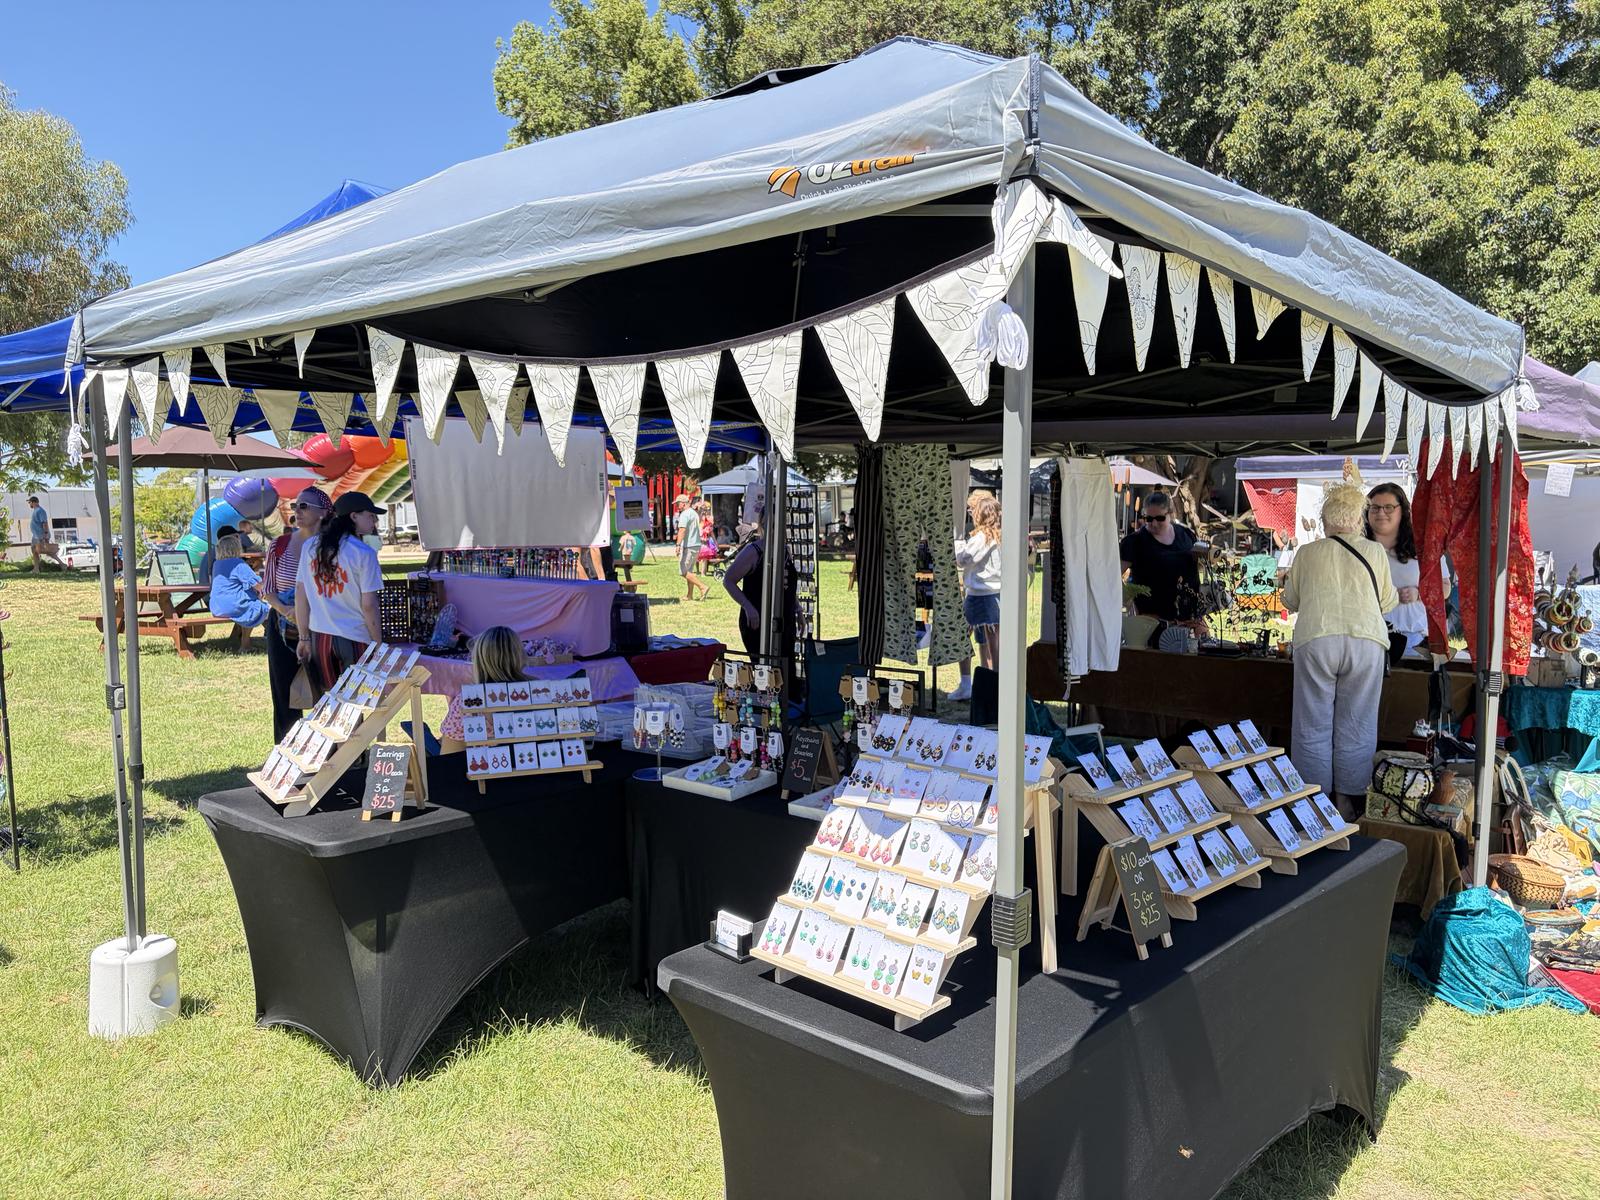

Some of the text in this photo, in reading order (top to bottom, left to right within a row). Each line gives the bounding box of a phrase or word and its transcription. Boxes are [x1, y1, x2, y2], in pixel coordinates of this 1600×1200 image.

[376, 749, 404, 761] Earrings
[373, 760, 394, 776] $10
[790, 758, 806, 778] $5
[374, 784, 390, 793] 3 for
[371, 794, 396, 809] $25
[1120, 851, 1152, 872] $10 each
[1134, 871, 1144, 884] OR
[1130, 890, 1154, 910] 3 for
[1140, 904, 1161, 928] $25
